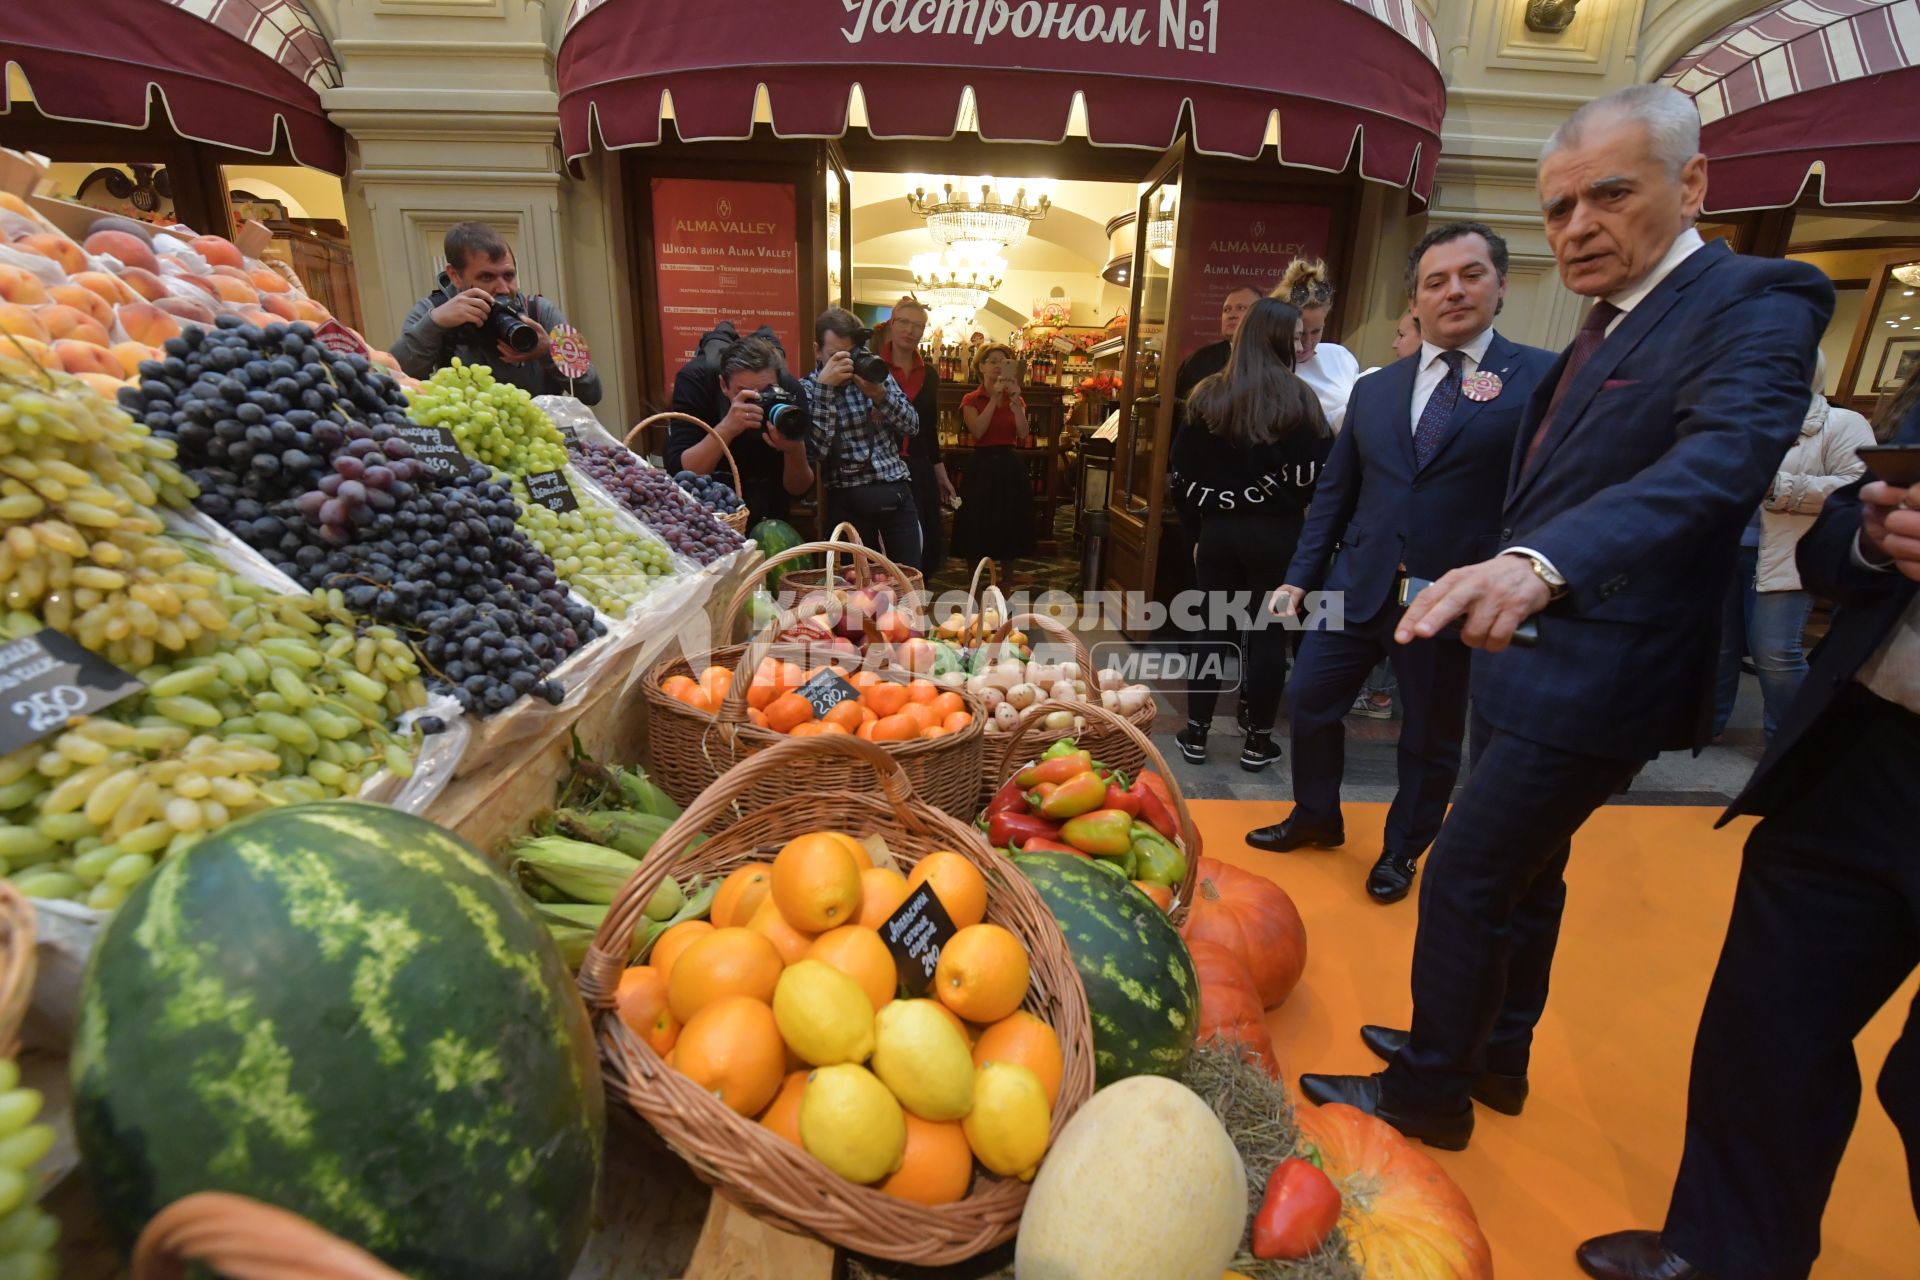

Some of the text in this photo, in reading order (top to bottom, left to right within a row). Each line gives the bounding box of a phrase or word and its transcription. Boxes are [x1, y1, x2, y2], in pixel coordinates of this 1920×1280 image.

[1158, 0, 1219, 54] №1
[676, 220, 777, 235] ALMA VALLEY
[1208, 240, 1305, 256] ALMA VALLEY
[11, 684, 88, 731] 250
